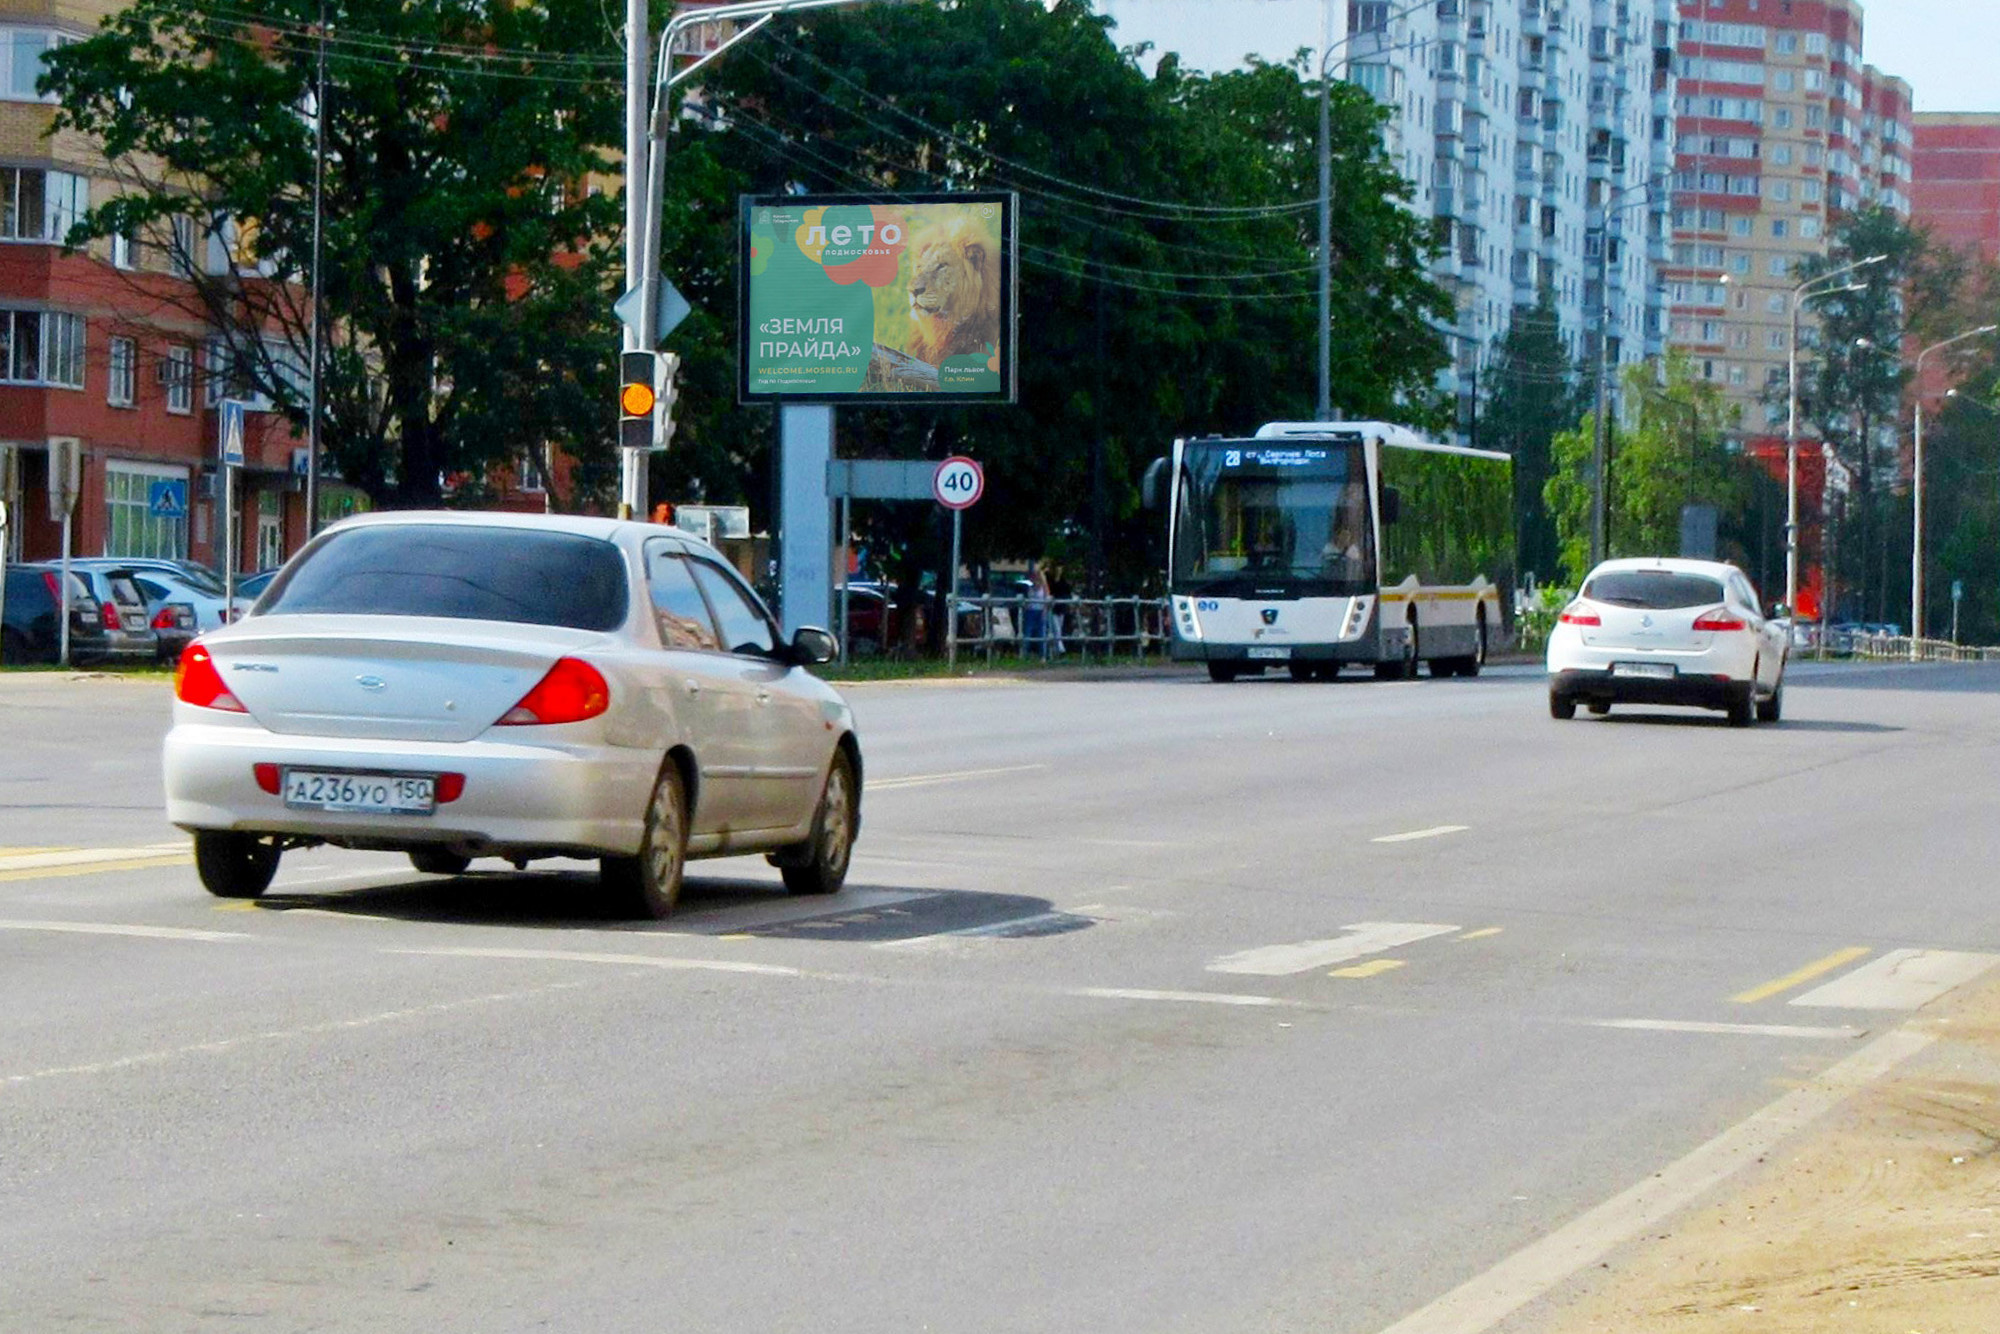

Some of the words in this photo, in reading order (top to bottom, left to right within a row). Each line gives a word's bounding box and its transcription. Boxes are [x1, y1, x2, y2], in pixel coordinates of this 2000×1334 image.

[759, 317, 844, 335] «ЗЕМЛЯ
[759, 337, 862, 360] ПРАЙДА»
[758, 366, 859, 375] WELCOME.MOSREG.RU
[944, 471, 974, 492] 40
